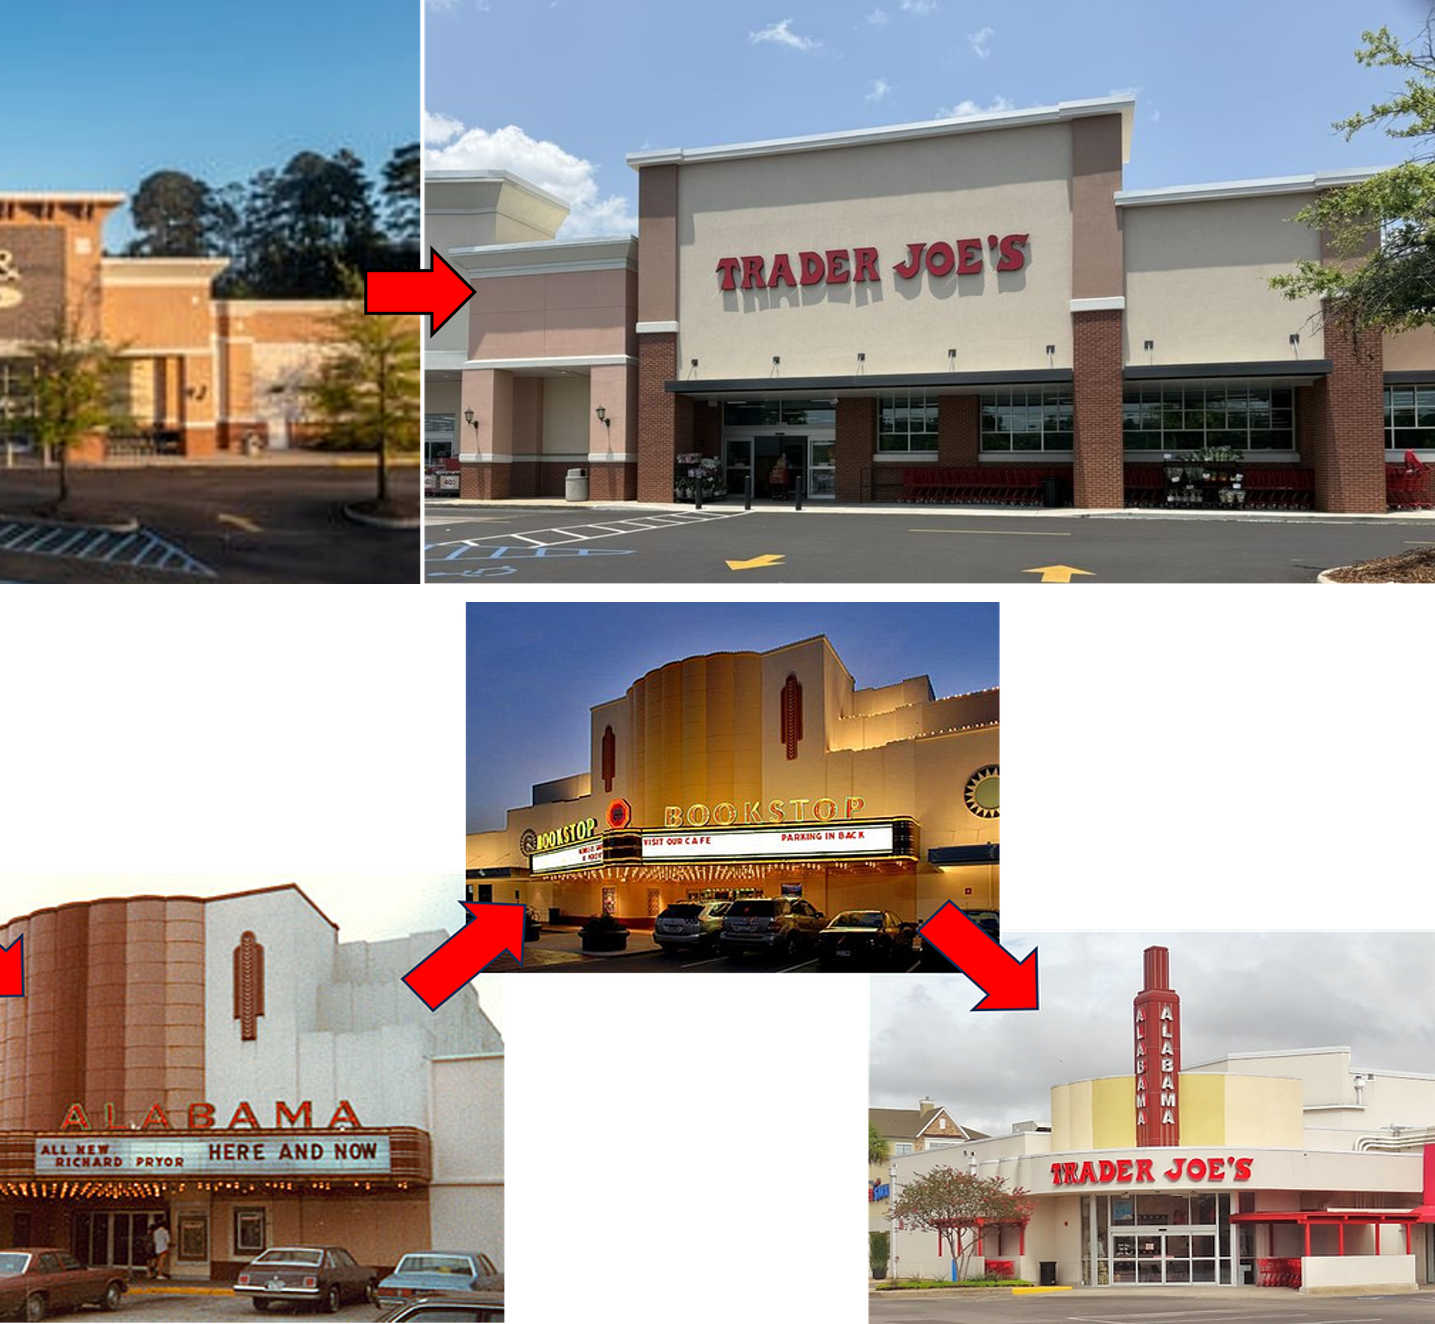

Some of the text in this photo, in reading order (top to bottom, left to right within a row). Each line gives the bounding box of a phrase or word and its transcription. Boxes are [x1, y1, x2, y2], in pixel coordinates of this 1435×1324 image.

[716, 233, 1030, 291] TRADER JOE'S
[664, 796, 867, 828] BOOKSTOP
[536, 817, 596, 850] BOOKSTOP
[643, 836, 664, 846] VISIT
[667, 837, 683, 846] OUR
[781, 831, 822, 842] PARKING
[825, 831, 836, 840] IN
[838, 830, 865, 840] BACK
[1135, 1006, 1148, 1126] ALABAMA
[1160, 1004, 1176, 1124] ALABAMA
[60, 1100, 362, 1130] ALABAMA
[41, 1141, 377, 1161] ALL NEW HERE AND NOW
[55, 1156, 185, 1167] RICHARD PRYOR
[1051, 1156, 1254, 1185] TRADER JOE'S
